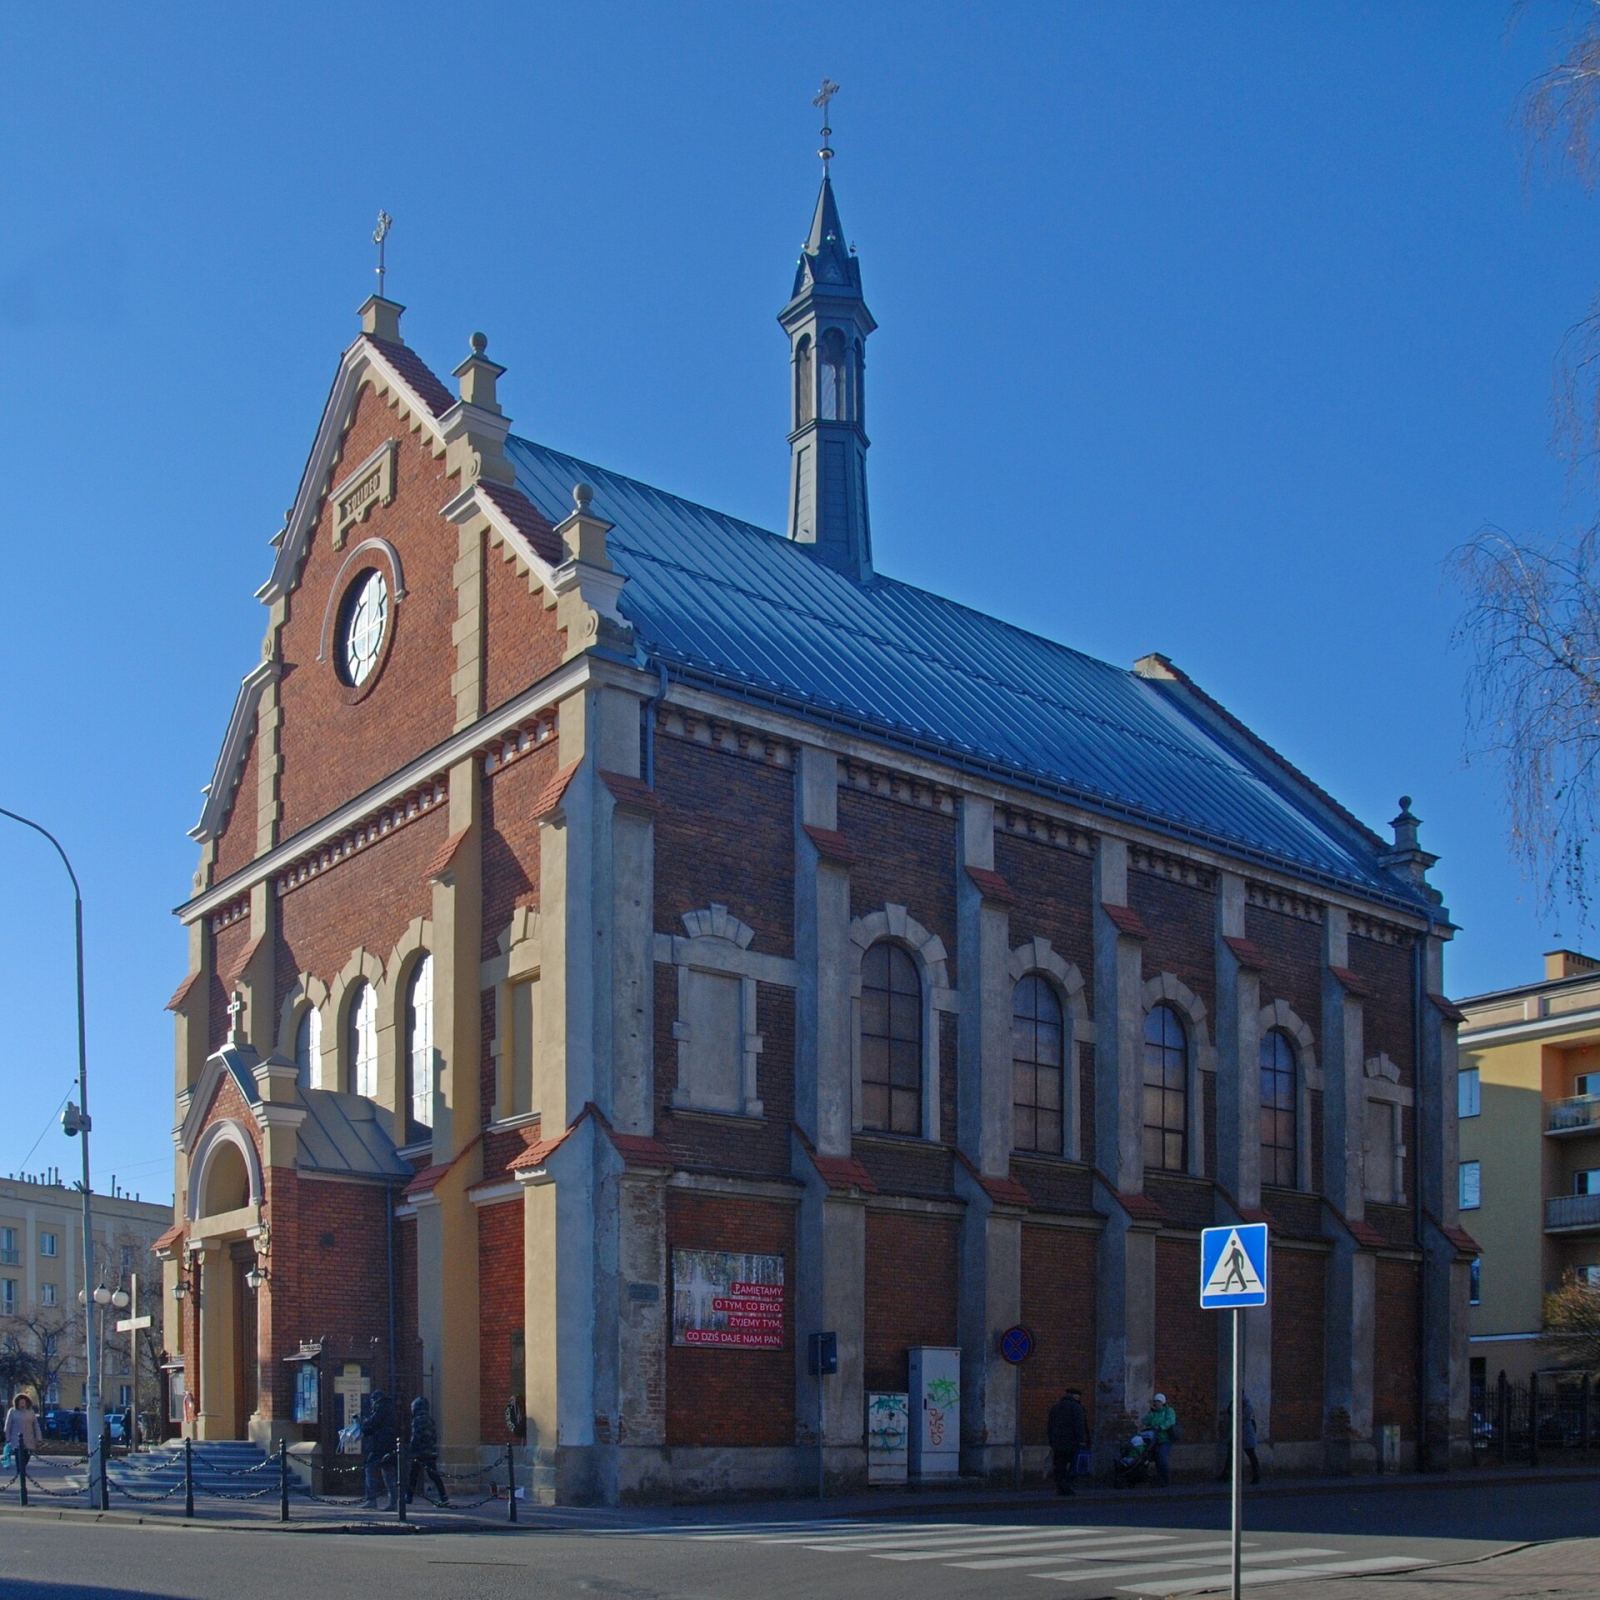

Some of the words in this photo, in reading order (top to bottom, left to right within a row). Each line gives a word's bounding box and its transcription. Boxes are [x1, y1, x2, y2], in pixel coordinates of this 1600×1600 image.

[715, 1300, 722, 1309] O
[724, 1301, 743, 1310] TYM,
[746, 1302, 757, 1310] CO
[687, 1332, 699, 1340] CO
[701, 1331, 719, 1341] DZIŚ
[721, 1334, 741, 1342] DAJE
[743, 1335, 762, 1343] NAM
